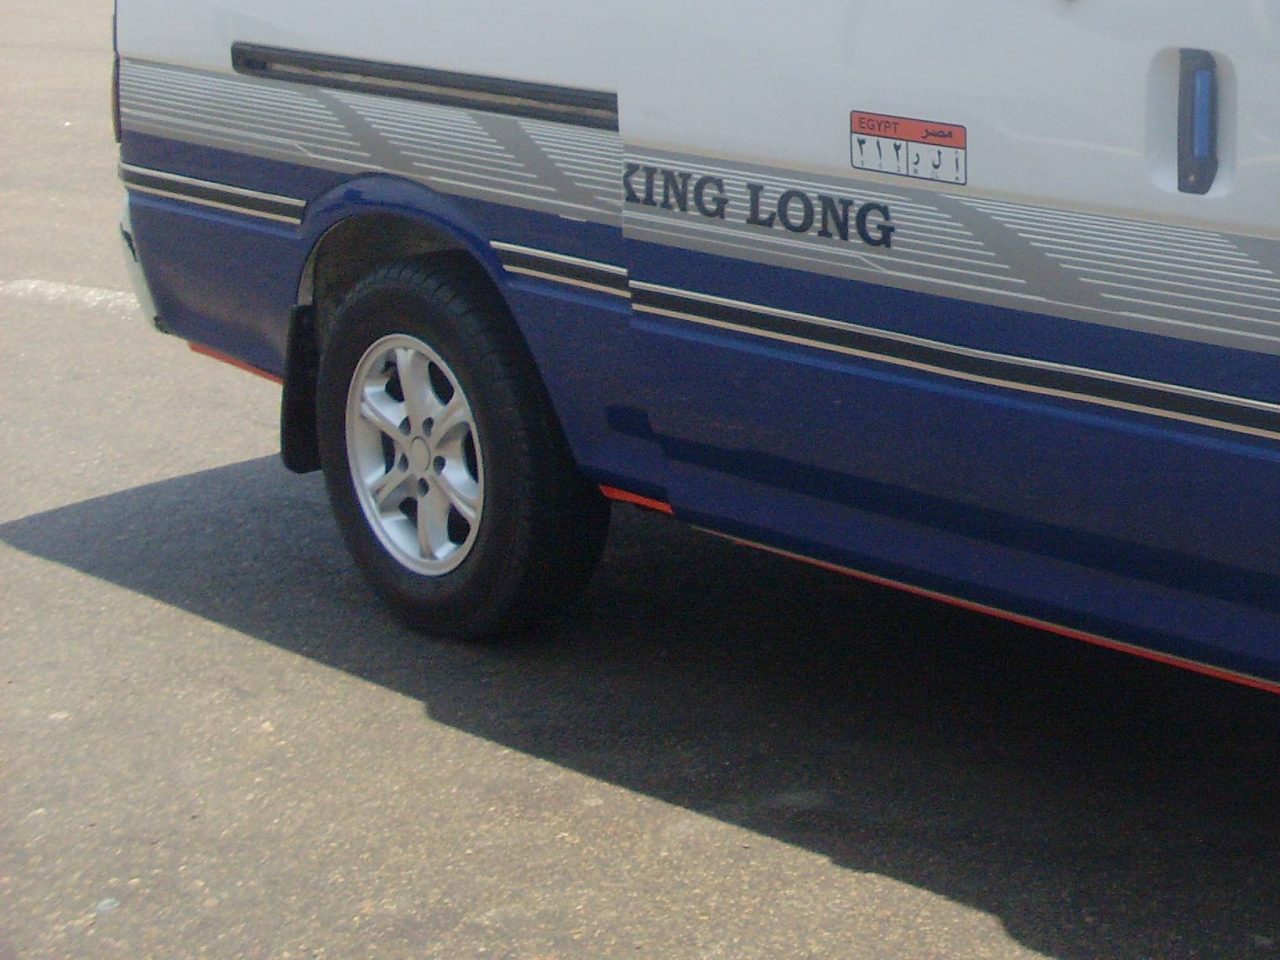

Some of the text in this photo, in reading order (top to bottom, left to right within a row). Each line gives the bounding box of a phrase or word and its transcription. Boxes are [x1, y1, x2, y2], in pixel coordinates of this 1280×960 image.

[859, 117, 899, 134] EGYPT
[921, 128, 953, 139] مصر
[747, 183, 895, 248] LONG
